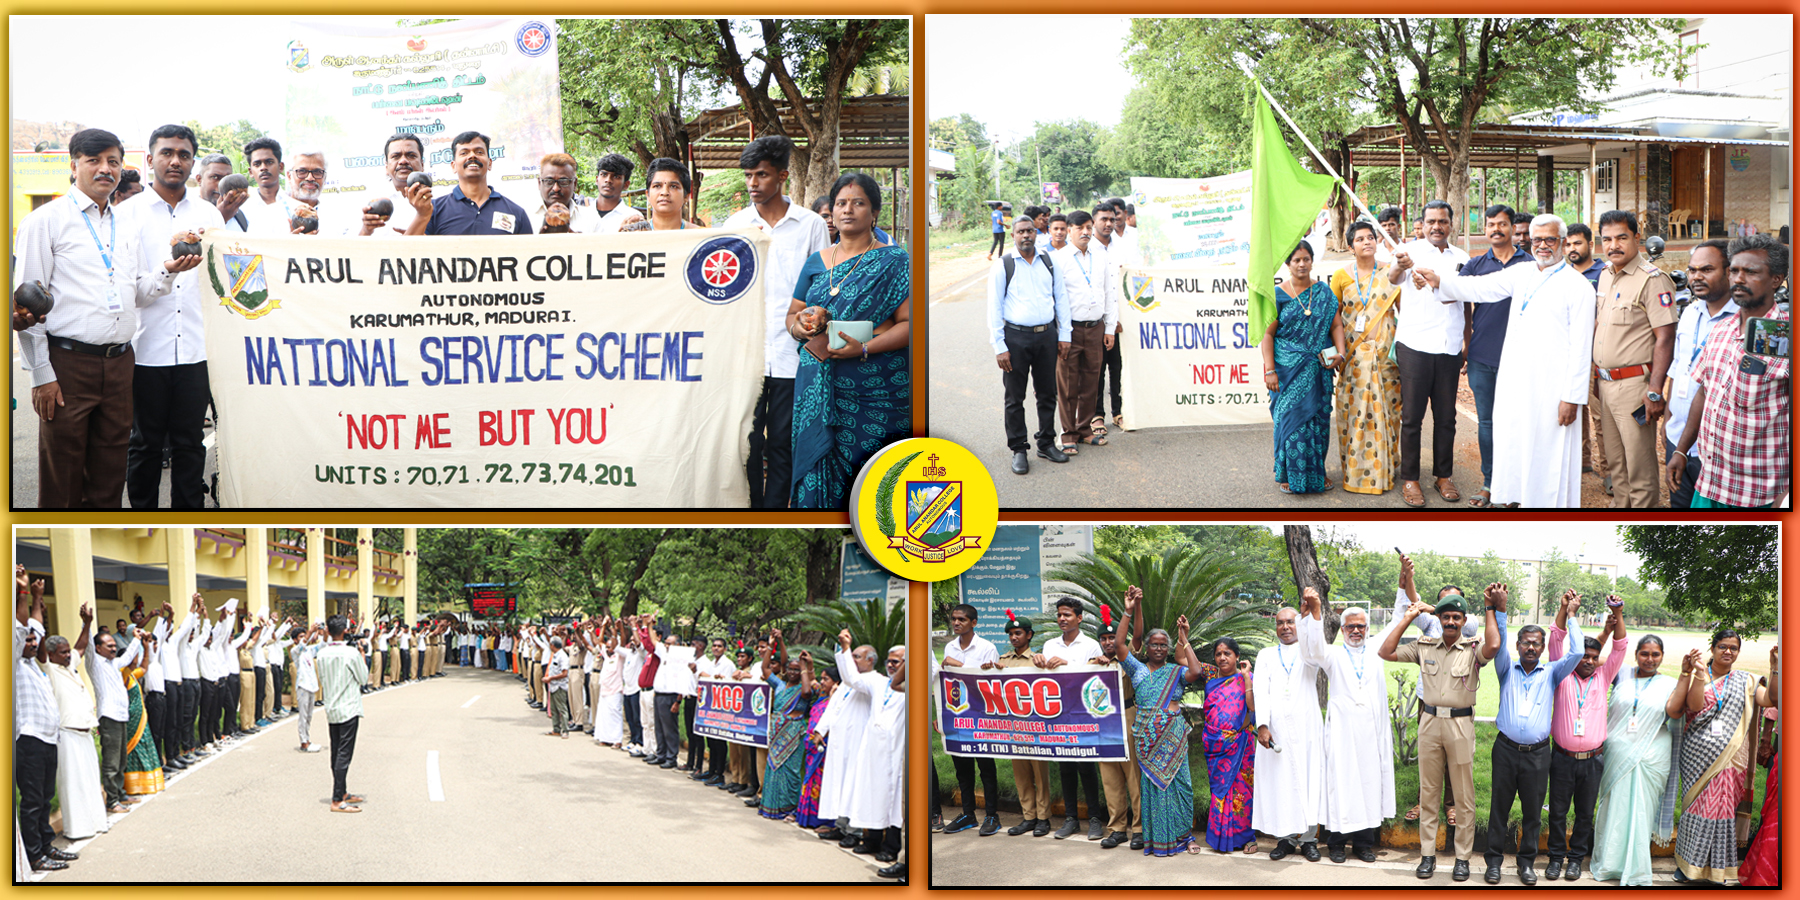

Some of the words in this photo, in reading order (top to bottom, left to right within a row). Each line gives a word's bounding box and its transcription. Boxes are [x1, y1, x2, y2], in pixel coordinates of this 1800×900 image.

[285, 257, 363, 284] ARUL
[378, 256, 518, 284] ANANDAR
[526, 252, 666, 280] COLLEGE
[708, 288, 726, 298] NSS
[1164, 278, 1204, 293] ARUL
[420, 292, 545, 307] AUTONOMOUS
[350, 313, 480, 329] KARUMATHUR,
[484, 310, 576, 324] MADURAI.
[1140, 322, 1226, 350] NATIONAL
[244, 336, 409, 387] NATIONAL
[420, 333, 564, 386] SERVICE
[576, 331, 704, 382] SCHEME
[1230, 364, 1250, 384] ME
[415, 413, 452, 448] ME
[478, 409, 535, 446] BUT
[711, 684, 744, 712] NCC
[977, 678, 1062, 718] NCC
[954, 718, 974, 729] ARUL
[978, 718, 1012, 730] ANANDAR
[1013, 720, 1046, 732] COLLEGE
[978, 744, 988, 752] 14
[1056, 746, 1100, 757] Dindigul.
